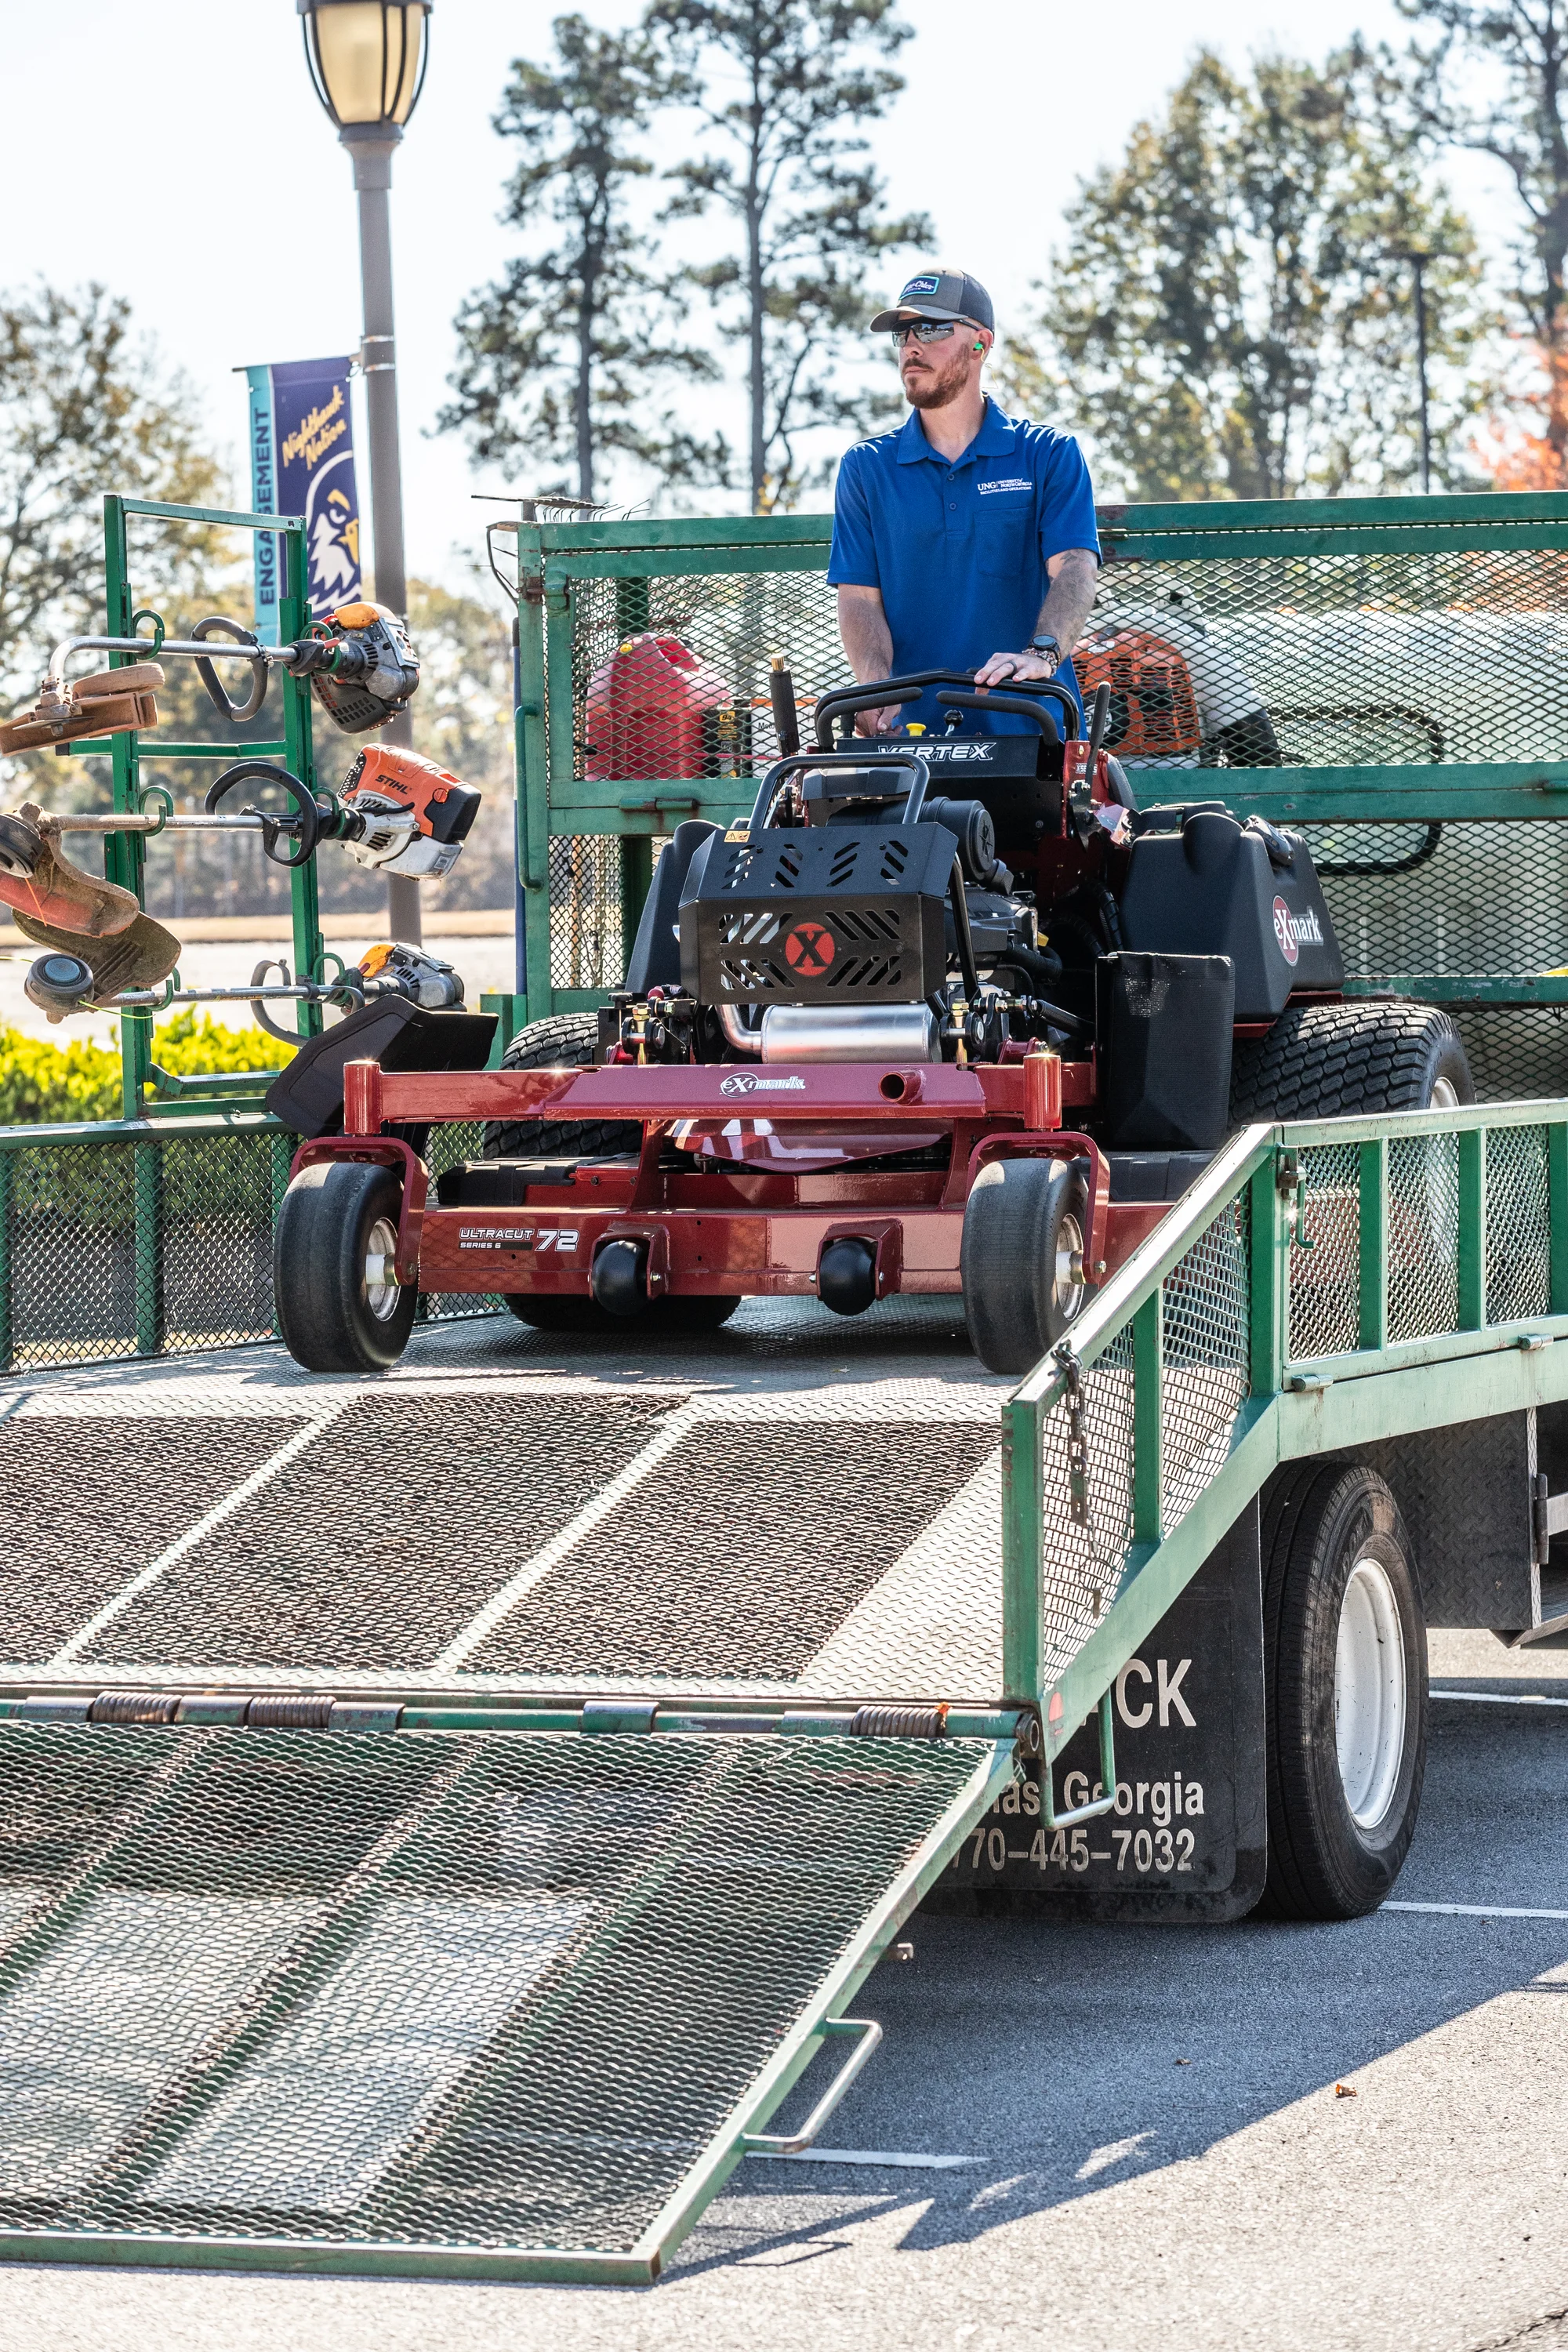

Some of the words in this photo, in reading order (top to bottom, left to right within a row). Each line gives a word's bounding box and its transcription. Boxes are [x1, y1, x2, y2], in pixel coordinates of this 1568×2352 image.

[282, 385, 345, 468] Nighthawk
[306, 419, 347, 470] Nation
[977, 481, 996, 491] UNG
[375, 774, 408, 795] STIHL
[1273, 906, 1323, 950] eXmark
[459, 1228, 534, 1240] ULTRACUT
[535, 1229, 579, 1252] 72
